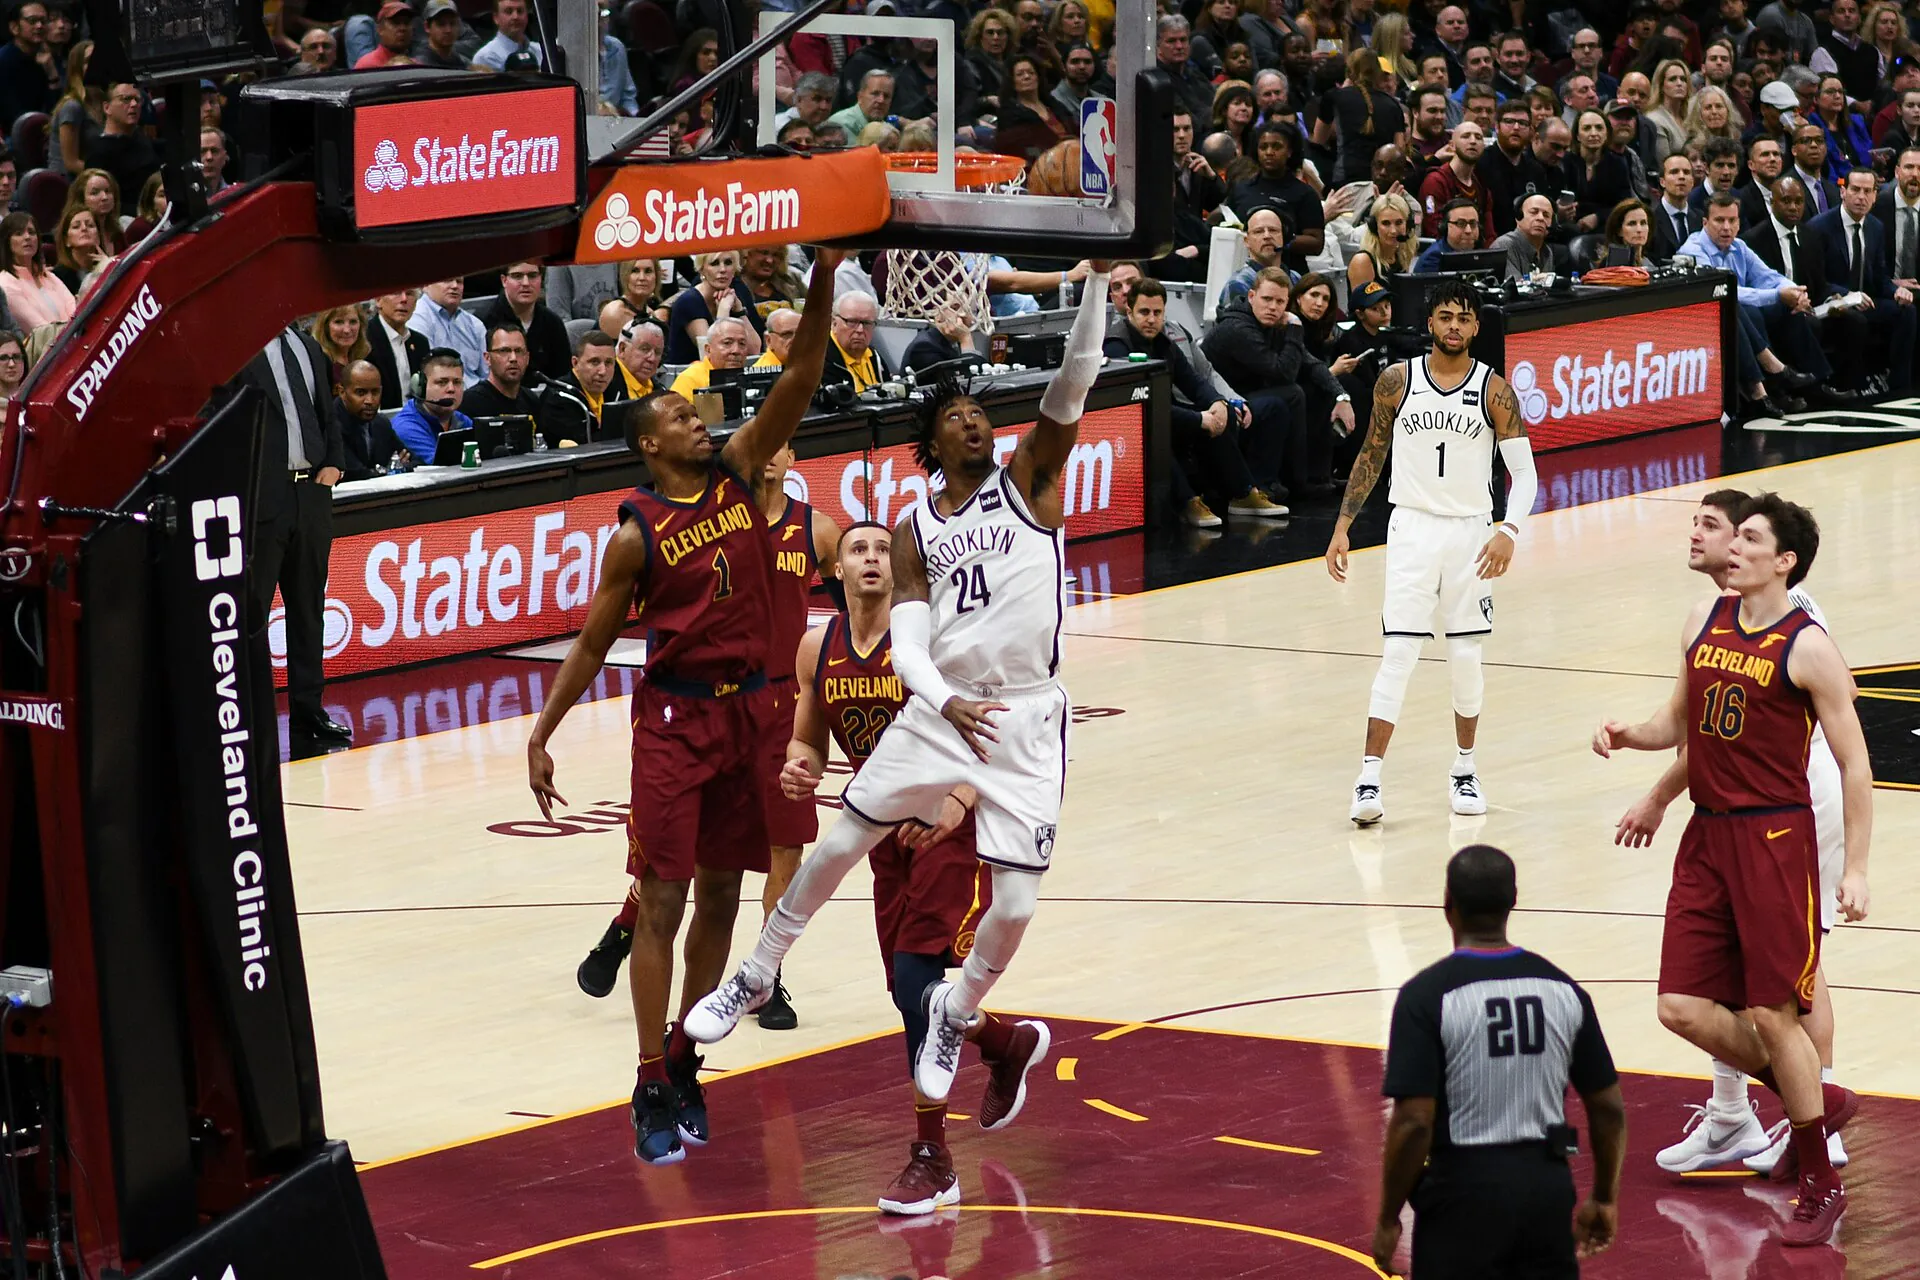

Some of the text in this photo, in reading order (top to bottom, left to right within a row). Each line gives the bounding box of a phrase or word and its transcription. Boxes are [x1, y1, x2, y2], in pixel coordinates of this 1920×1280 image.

[1085, 172, 1103, 189] NBA
[743, 365, 782, 375] SAMSUNG
[1401, 410, 1485, 440] BROOKLYN
[1435, 442, 1446, 478] 1
[981, 494, 999, 507] infor
[659, 502, 753, 567] CLEVELAND
[711, 546, 733, 602] 1
[950, 563, 992, 615] 24
[825, 675, 903, 704] CLEVELAND
[1693, 643, 1776, 688] CLEVELAND
[840, 705, 893, 758] 22
[1699, 680, 1747, 741] 16
[208, 592, 270, 992] Cleveland Clinic
[1484, 995, 1546, 1058] 20
